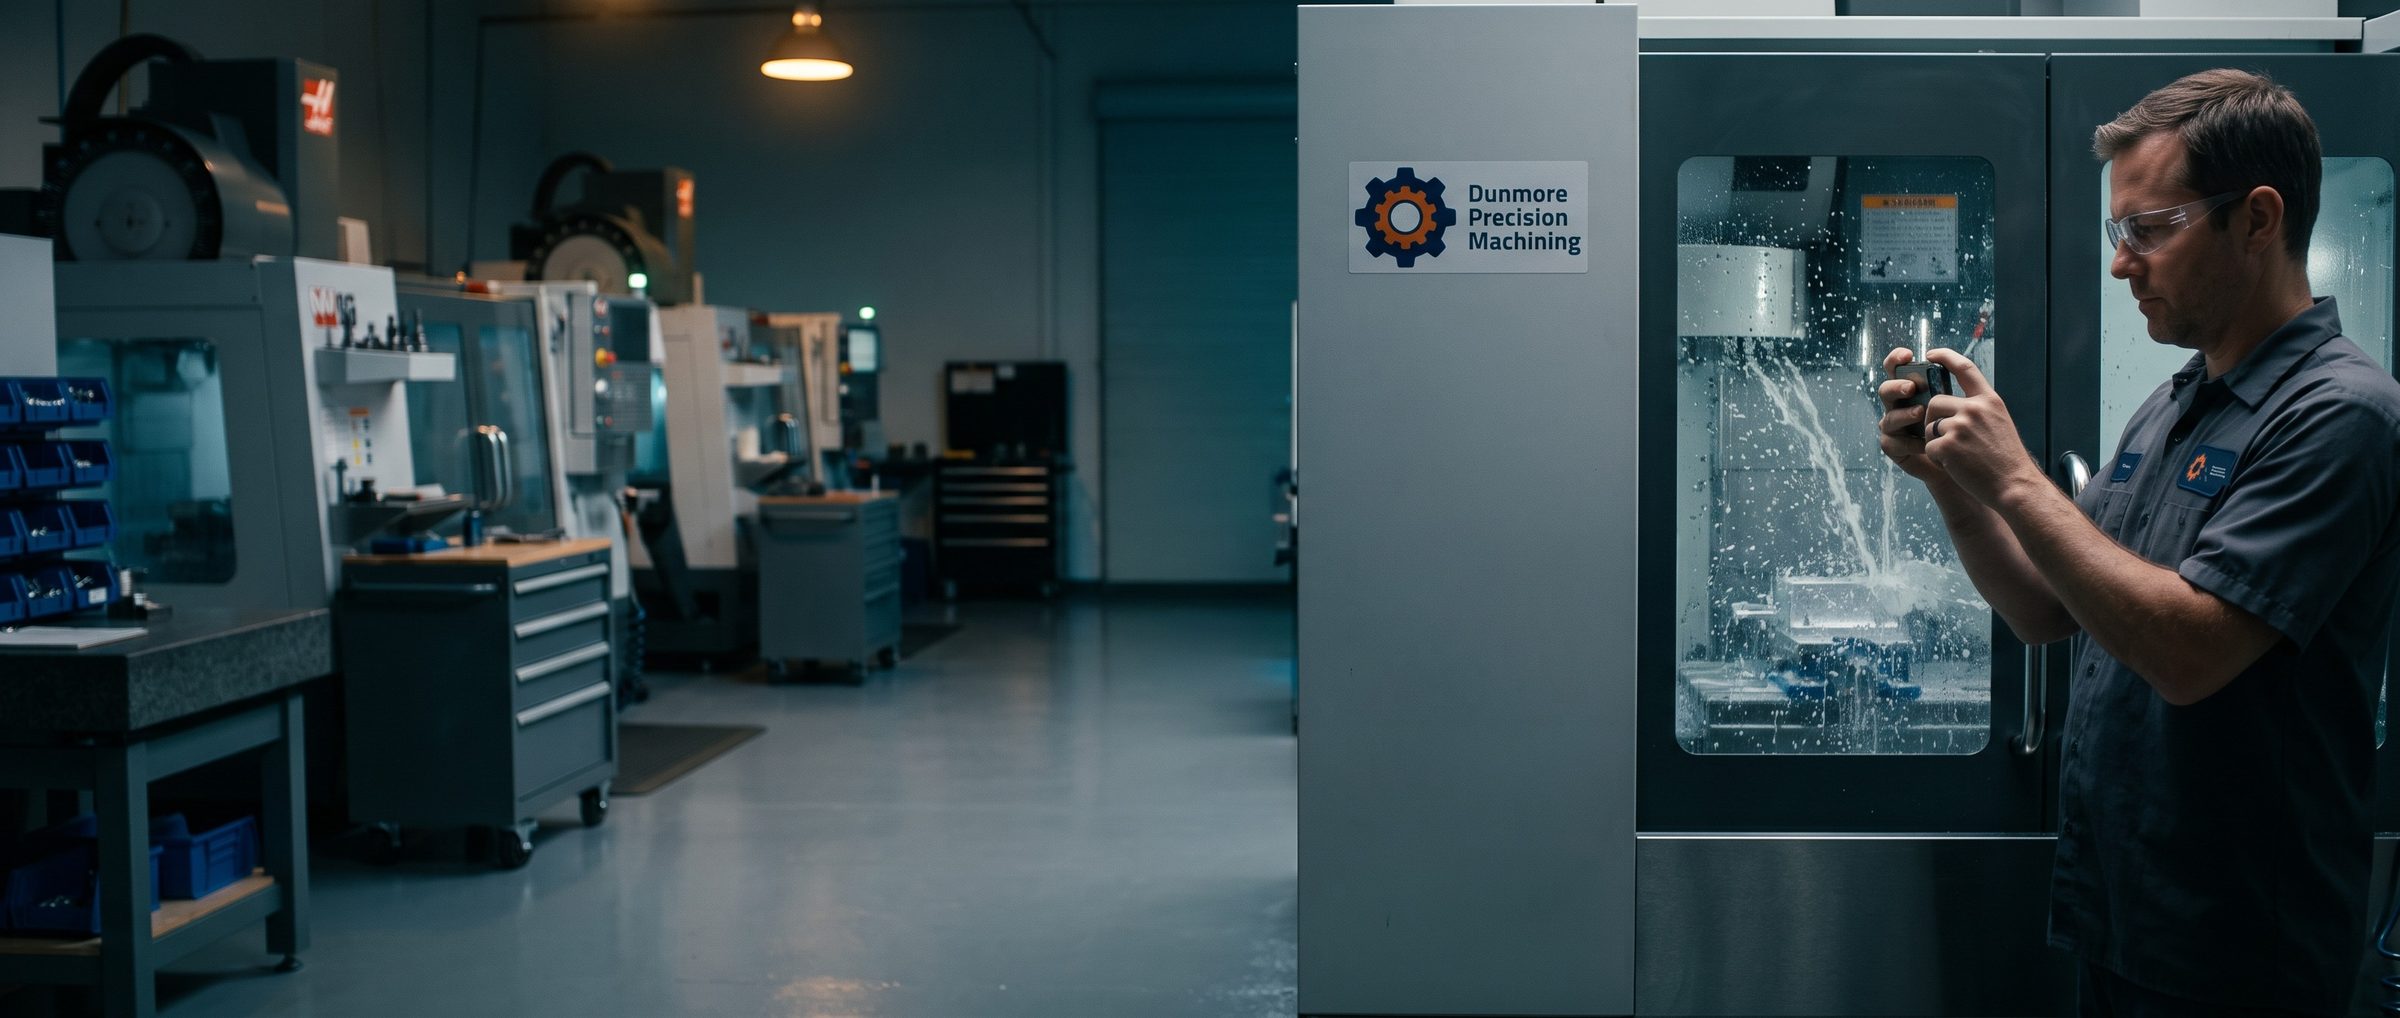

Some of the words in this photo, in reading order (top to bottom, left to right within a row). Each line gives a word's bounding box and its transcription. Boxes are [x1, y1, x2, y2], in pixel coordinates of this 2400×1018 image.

[1469, 184, 1567, 202] Dunmore
[1469, 207, 1567, 226] Precision
[1469, 231, 1581, 255] Machining
